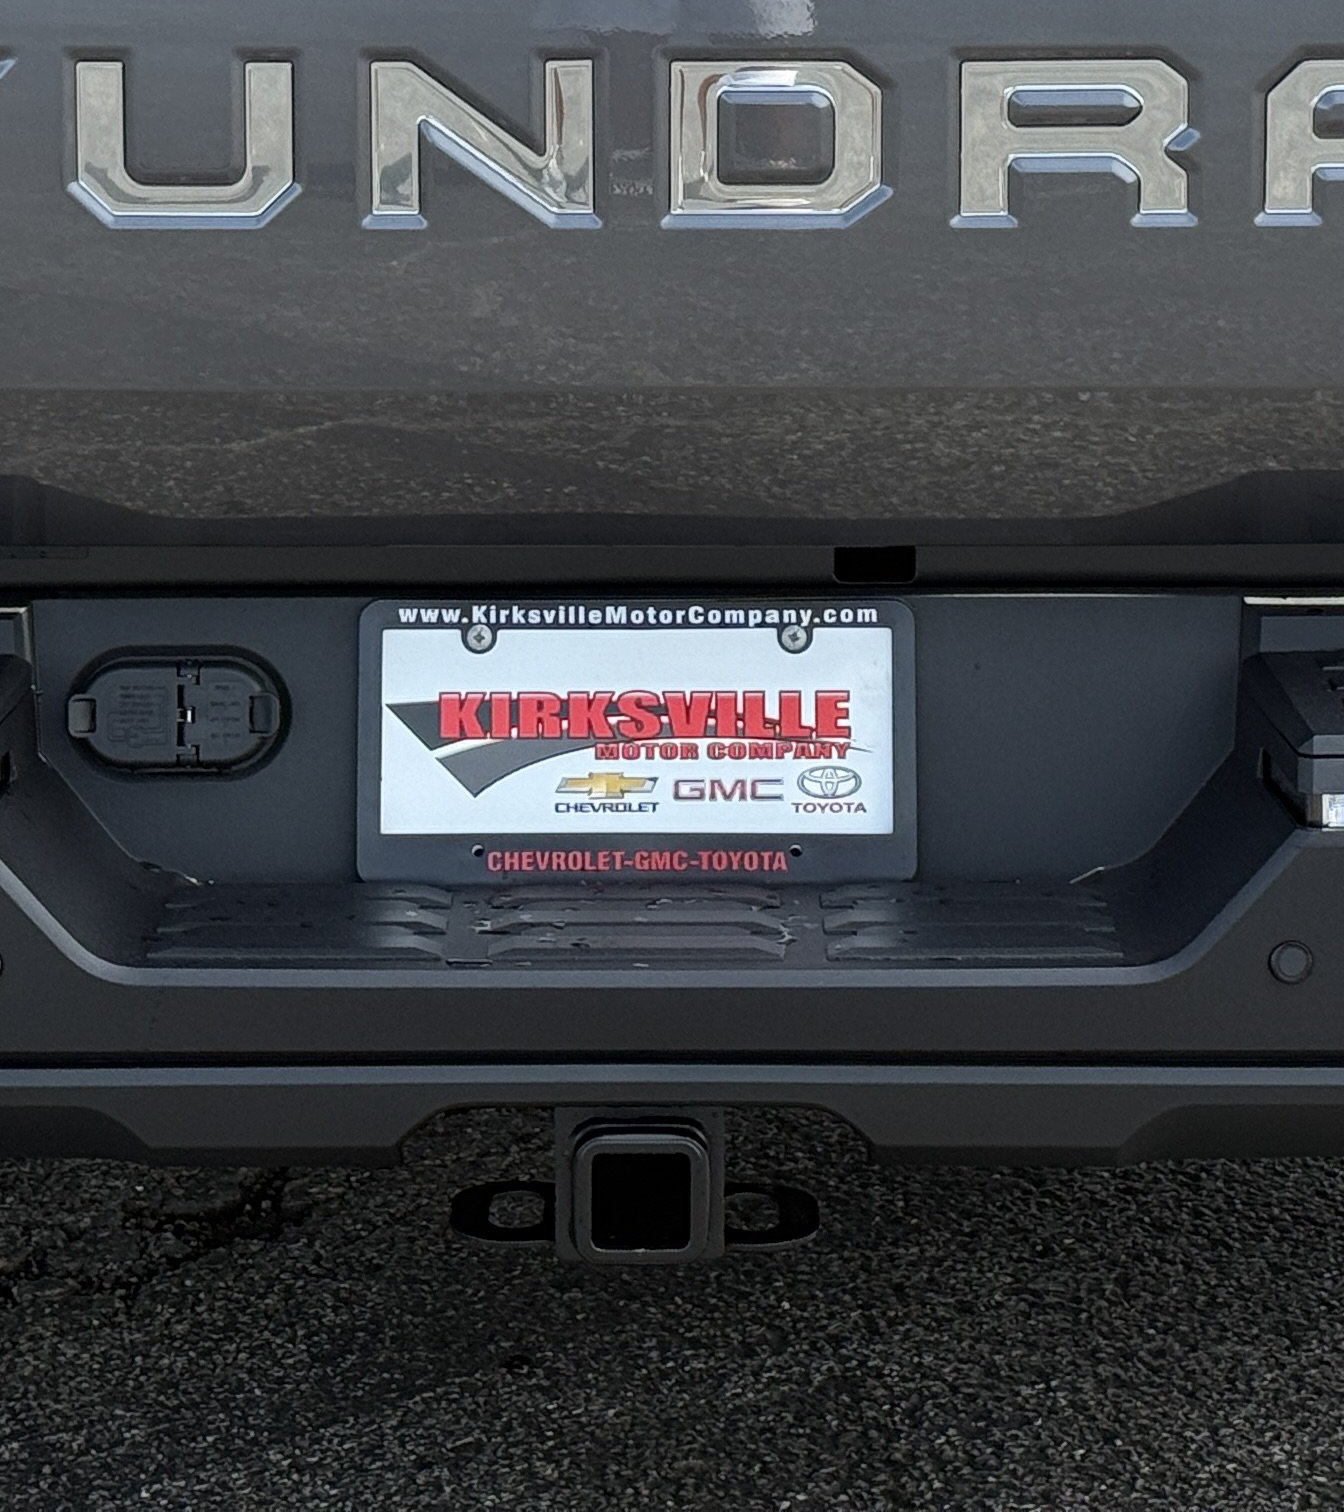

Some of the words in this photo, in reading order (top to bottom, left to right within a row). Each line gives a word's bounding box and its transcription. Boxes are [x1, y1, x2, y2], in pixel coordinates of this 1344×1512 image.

[397, 605, 878, 627] www.KirksvilleMotorCompany.com
[438, 690, 852, 740] KIRKSVILLE
[594, 742, 699, 761] MOTOR
[706, 742, 851, 760] COMPANY
[672, 778, 786, 802] GMC
[554, 801, 660, 814] CHEVROLET
[791, 801, 867, 814] TOYOTA
[486, 850, 789, 873] CHEVROLET-GMC-TOYOTA
